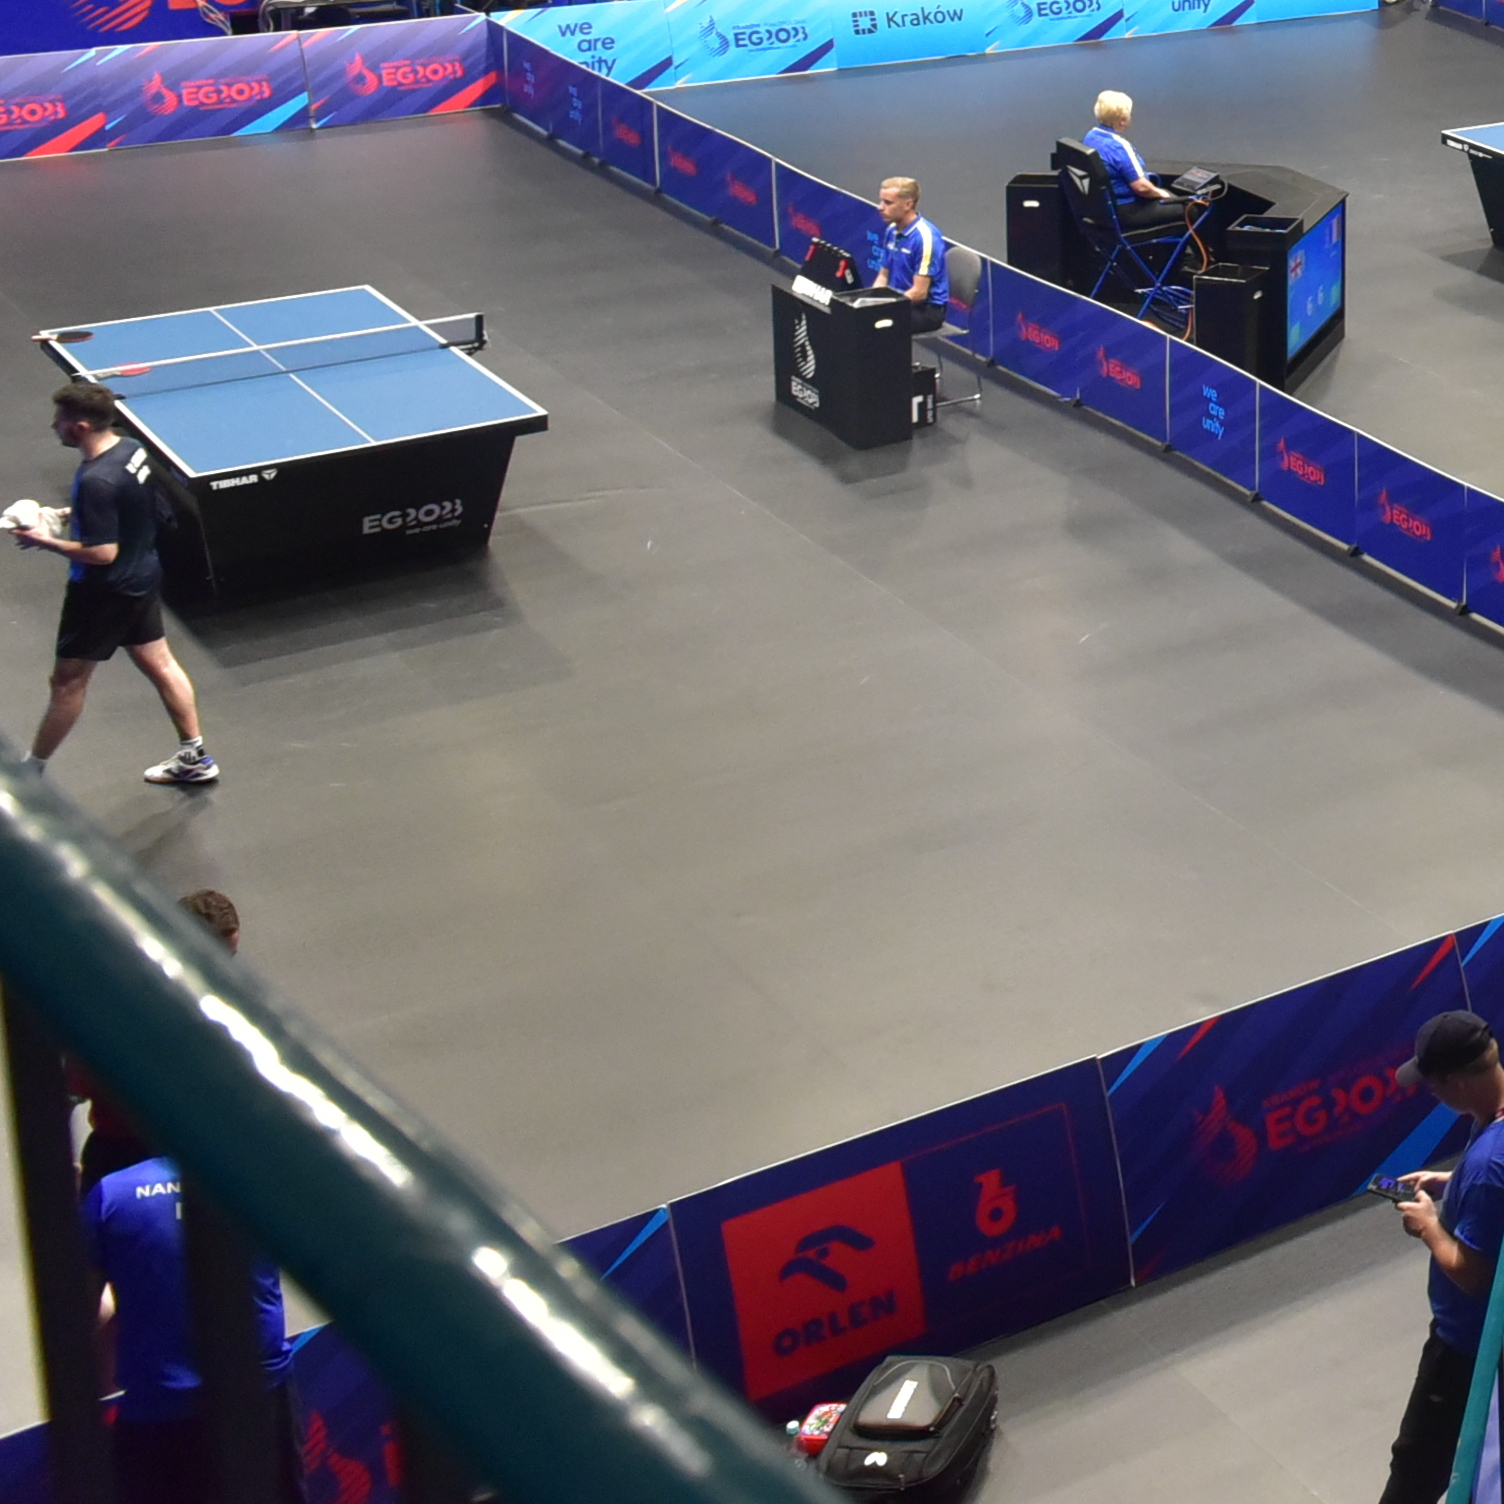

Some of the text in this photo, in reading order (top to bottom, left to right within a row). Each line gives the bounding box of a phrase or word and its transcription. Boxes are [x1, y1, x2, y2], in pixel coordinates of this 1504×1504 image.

[886, 4, 963, 30] Kraków
[558, 22, 593, 38] we
[734, 25, 808, 49] EG2023
[577, 35, 615, 51] are
[381, 61, 465, 87] EG2023
[182, 77, 271, 106] EG2023
[1203, 385, 1217, 400] we
[1209, 402, 1225, 419] are
[1202, 417, 1224, 440] unity
[210, 474, 259, 490] TIBHAR
[362, 499, 463, 535] EG2023
[1393, 511, 1432, 540] EG2023
[1265, 1067, 1417, 1150] EG202
[136, 1182, 181, 1199] NAN
[950, 1224, 1062, 1281] BENZINA
[773, 1290, 896, 1357] ORLEN
